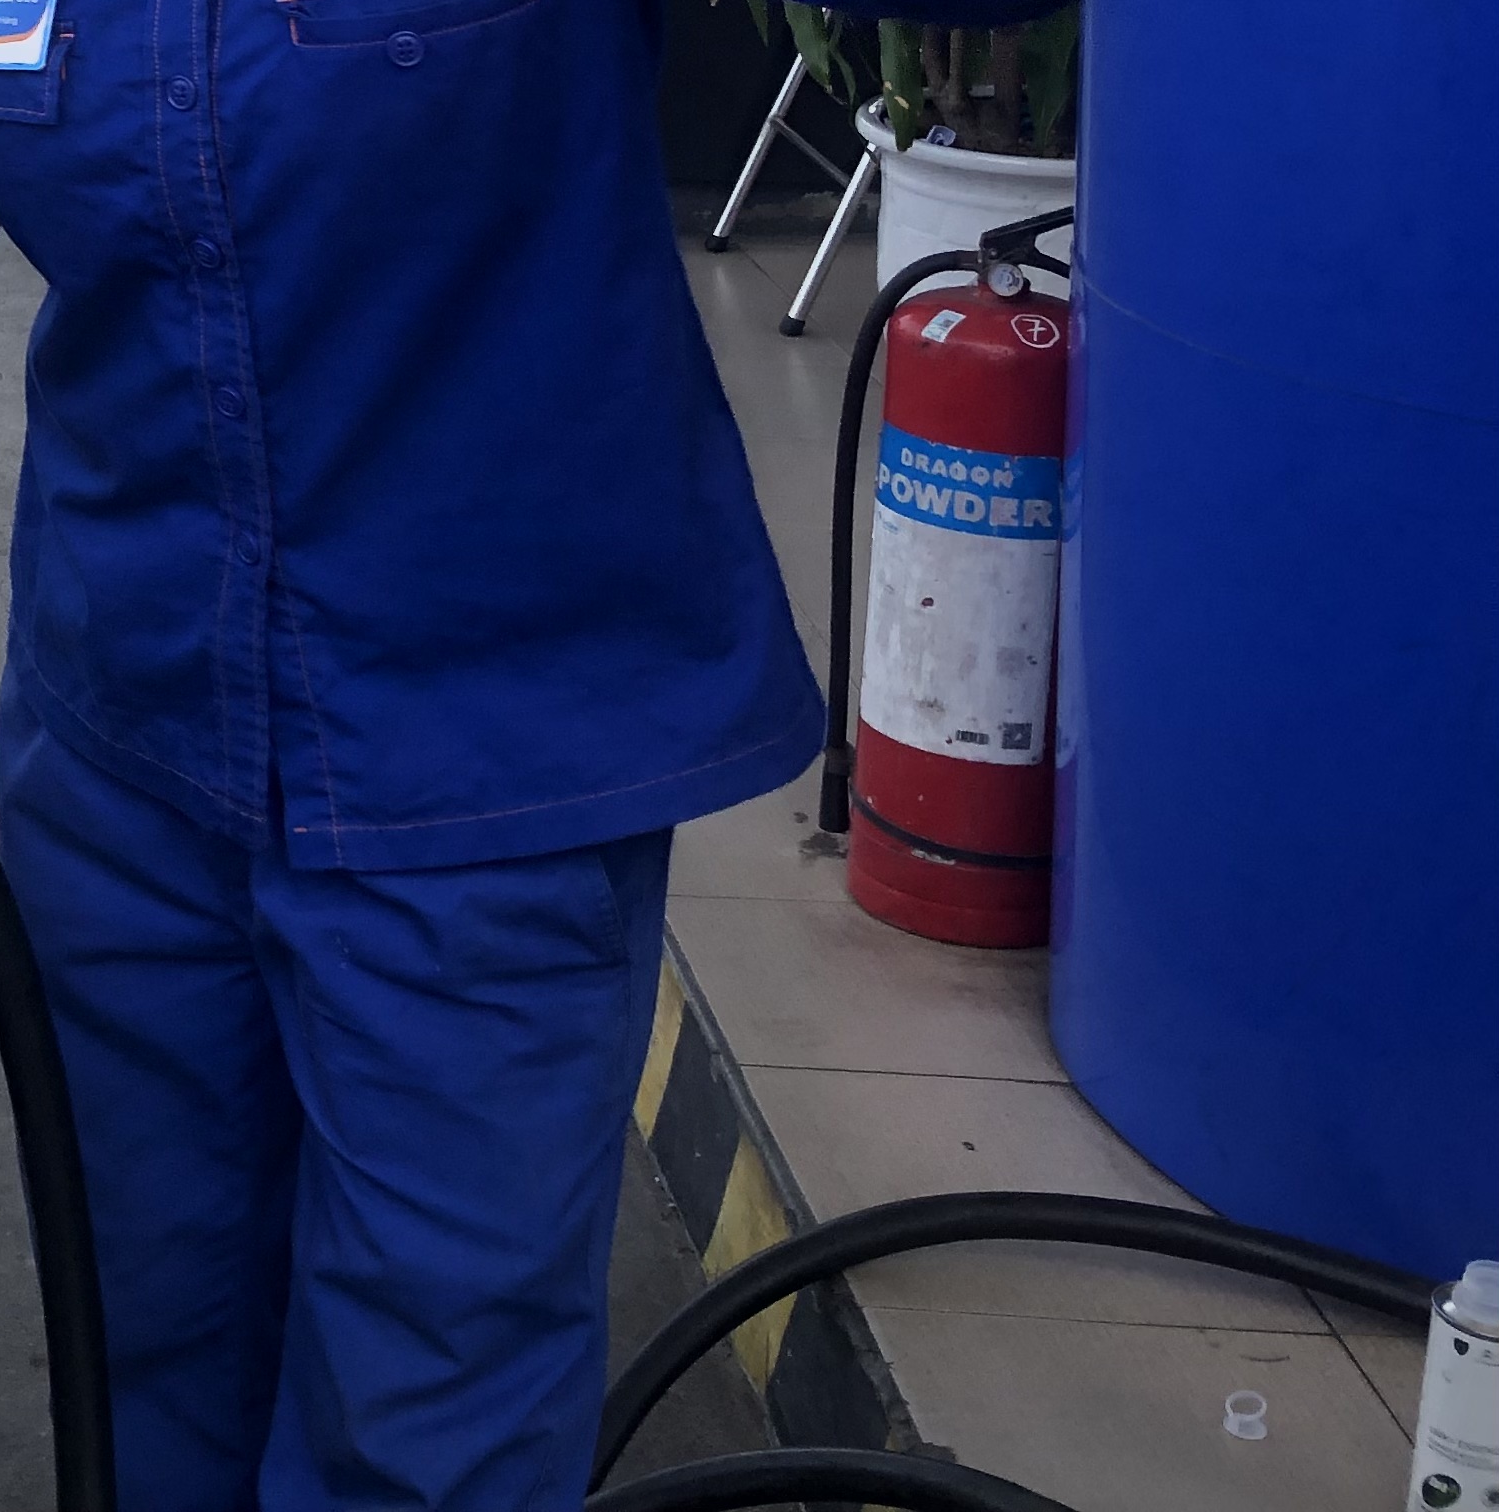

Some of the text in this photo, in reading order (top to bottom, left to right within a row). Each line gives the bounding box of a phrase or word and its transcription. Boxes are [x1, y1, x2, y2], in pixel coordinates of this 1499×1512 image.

[1021, 317, 1047, 342] 7
[901, 447, 1015, 489] DRAGON
[878, 462, 1053, 527] POWDER
